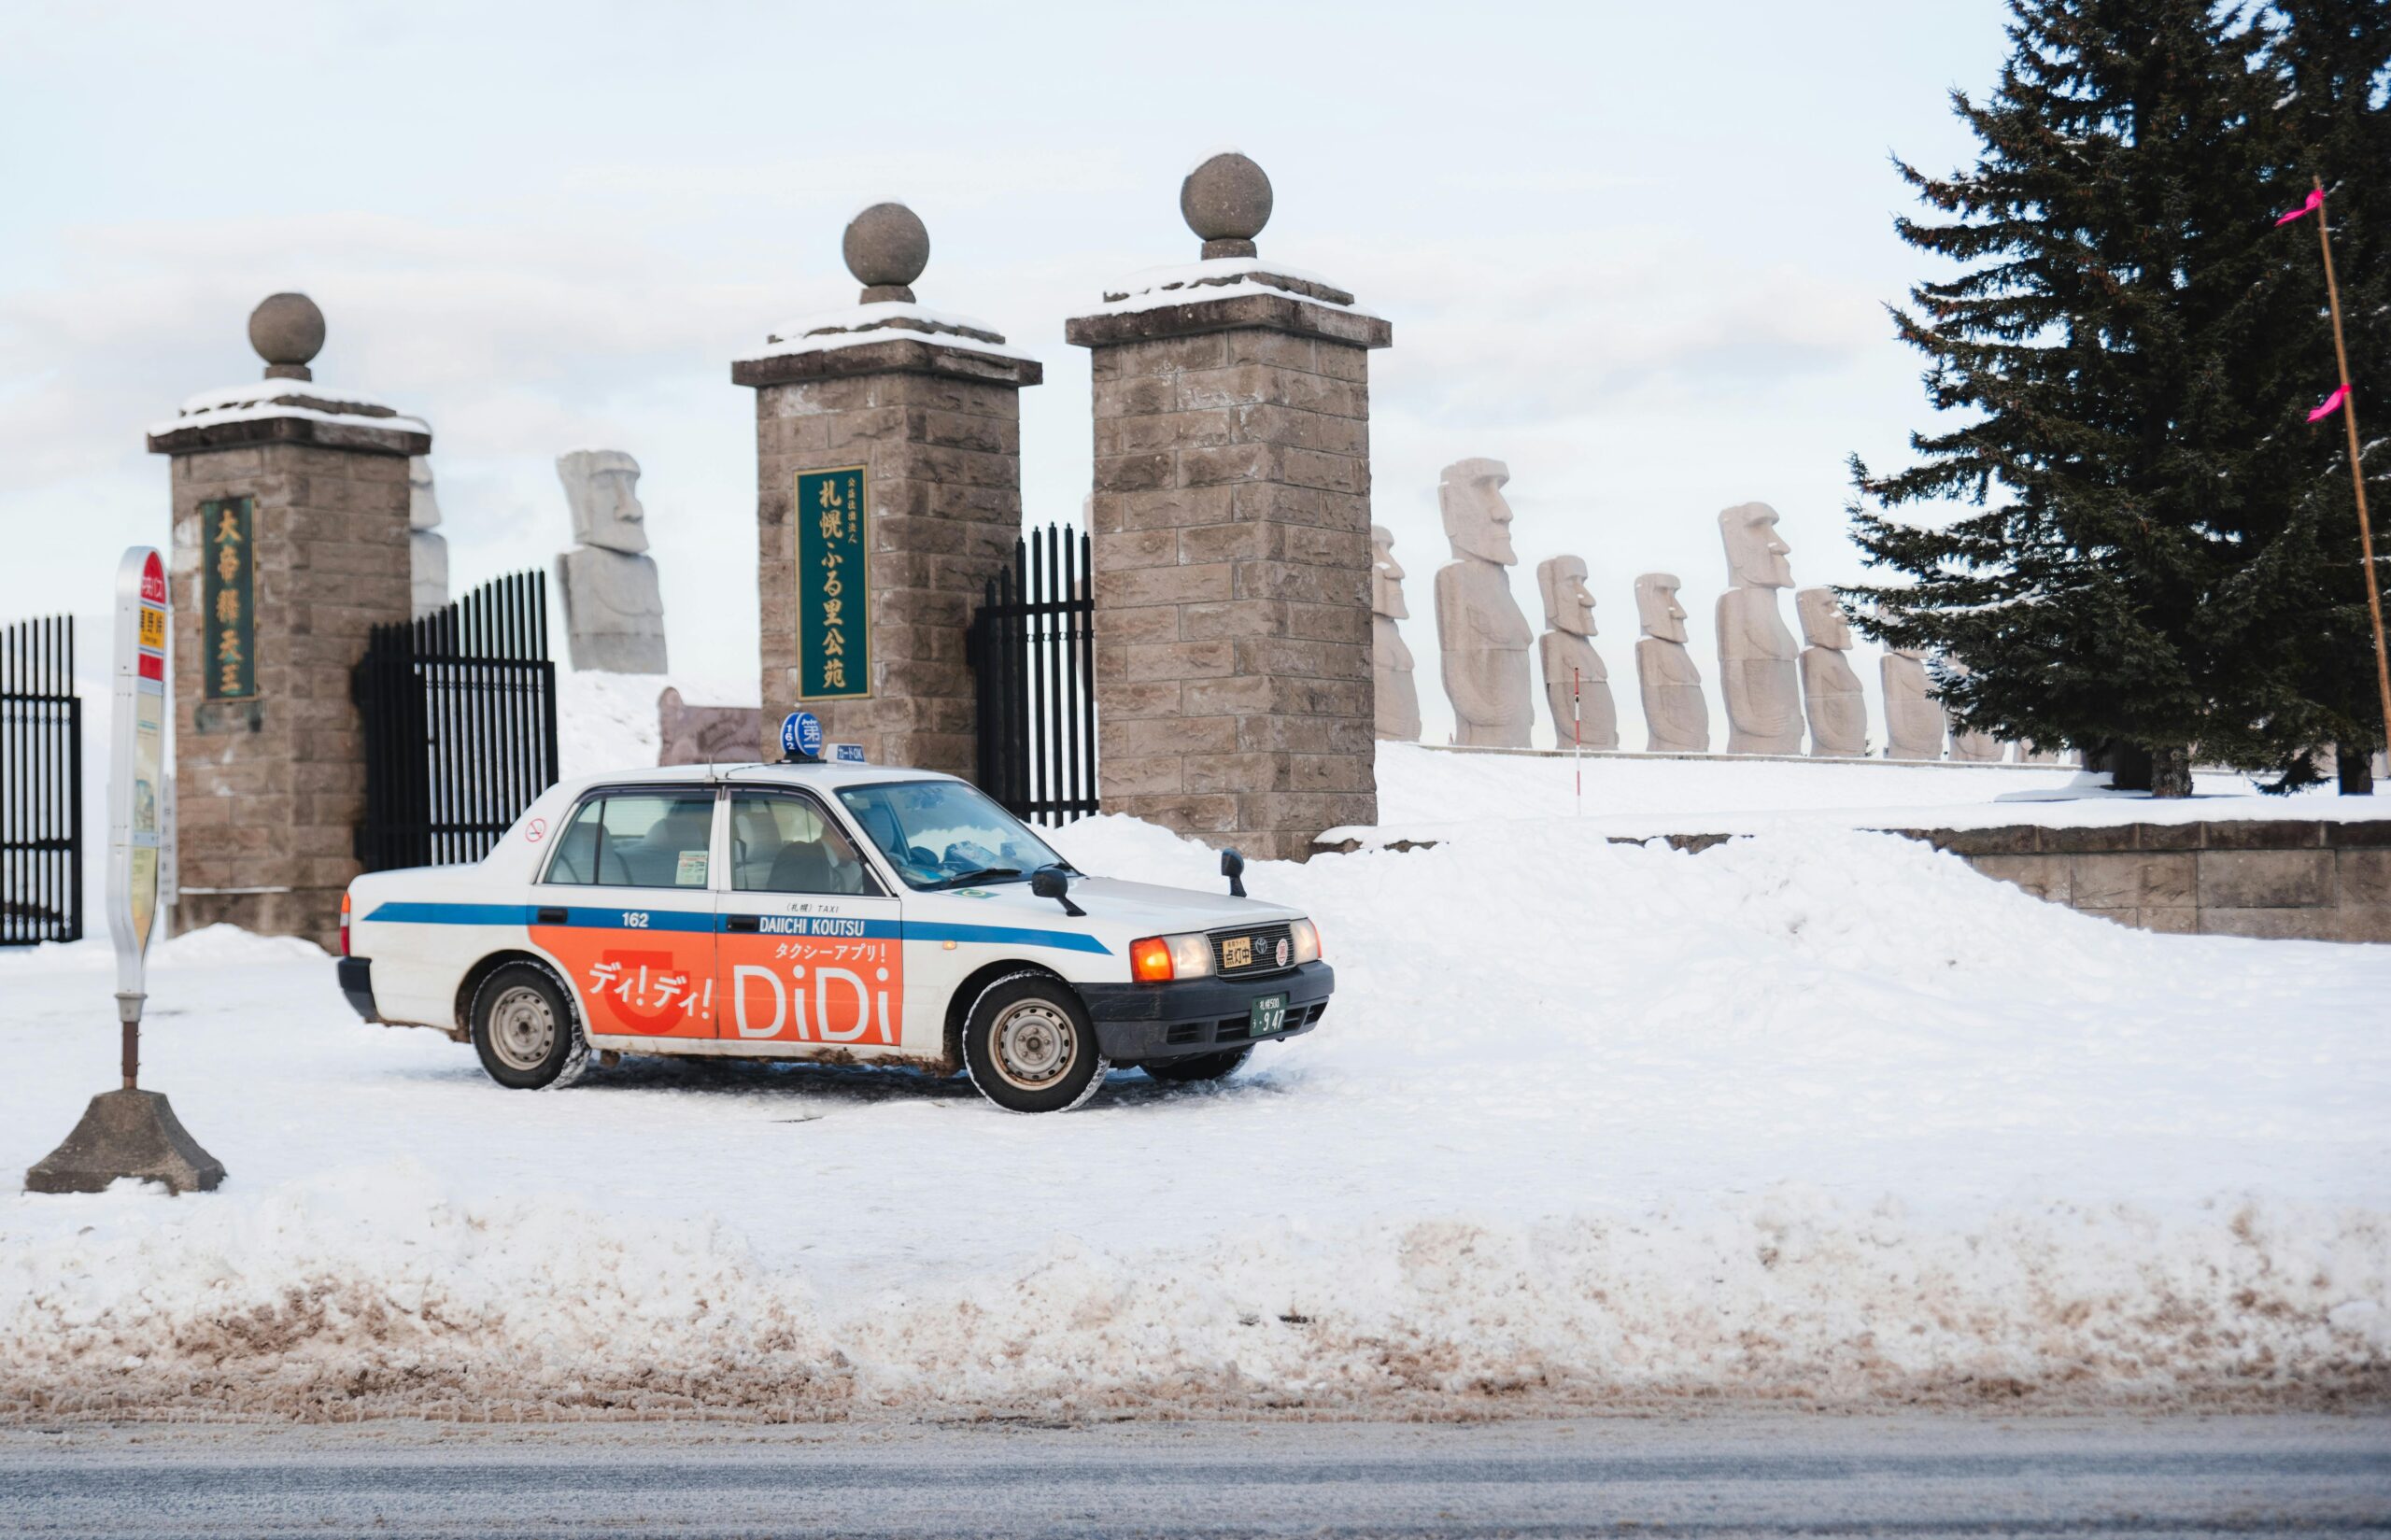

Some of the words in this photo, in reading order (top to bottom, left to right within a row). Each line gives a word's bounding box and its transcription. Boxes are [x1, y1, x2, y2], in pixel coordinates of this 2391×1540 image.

[818, 479, 846, 688] 札幌ふる里公苑
[785, 724, 795, 750] 162
[801, 718, 821, 748] 第一
[838, 747, 863, 760] カードOK
[622, 911, 649, 927] 162
[817, 905, 840, 913] TAXI
[759, 916, 807, 934] DAIICHI
[812, 918, 865, 937] KOUTSU
[775, 942, 885, 963] タクシーアプリ!
[1225, 946, 1250, 966] 点灯中
[733, 964, 893, 1043] DiDi
